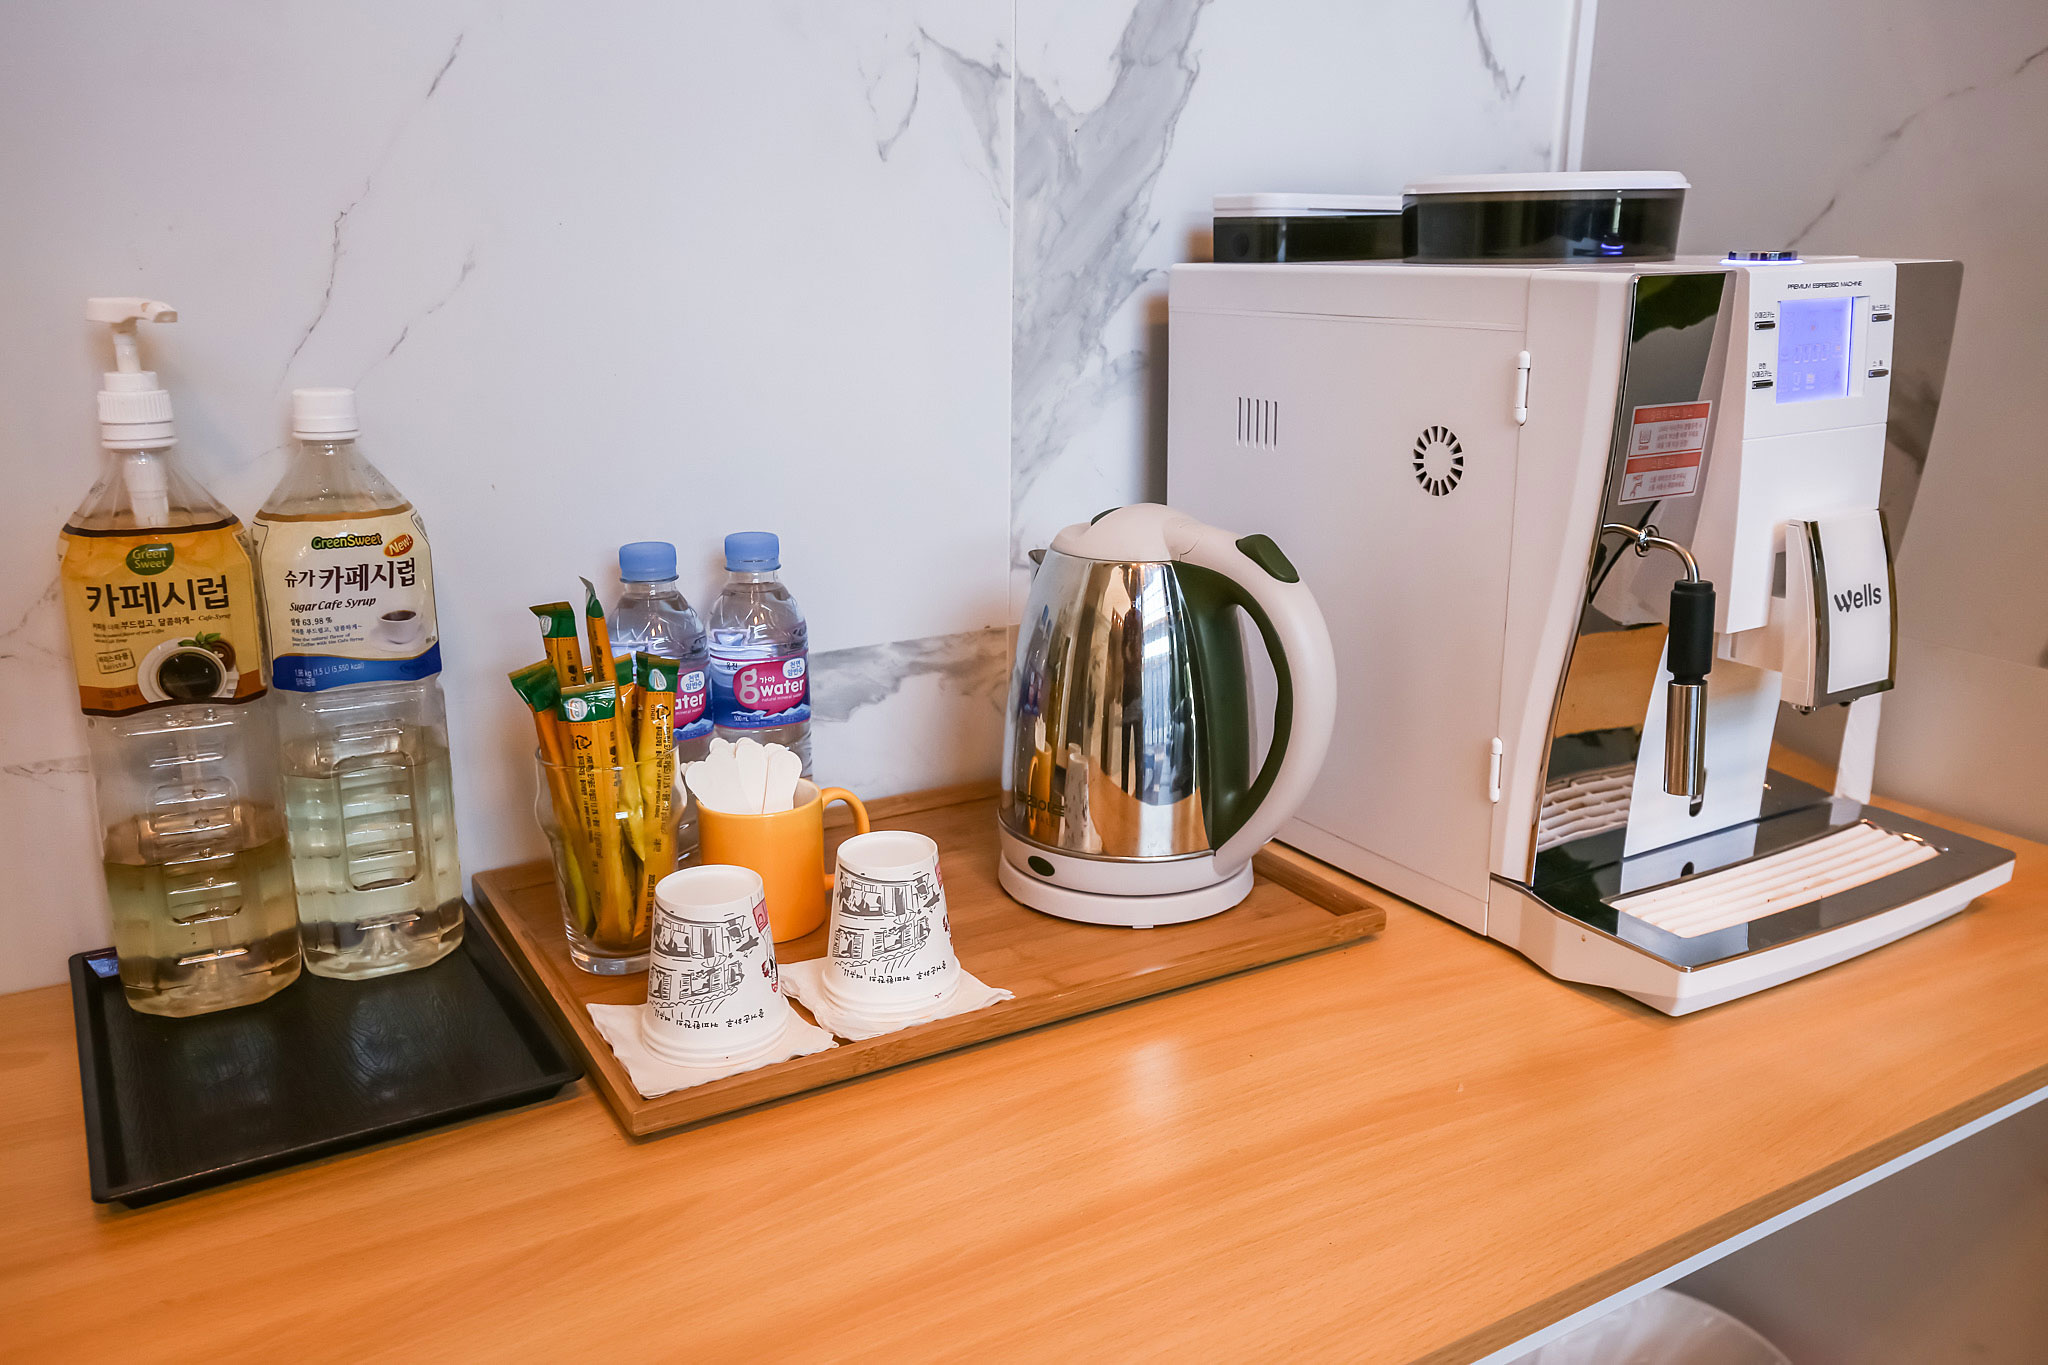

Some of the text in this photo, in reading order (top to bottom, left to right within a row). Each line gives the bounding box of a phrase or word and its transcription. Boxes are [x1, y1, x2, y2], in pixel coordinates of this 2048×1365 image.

[1812, 281, 1840, 289] ESPRESSO
[311, 532, 383, 550] GreenSweet
[388, 534, 413, 555] New!
[132, 548, 167, 560] Green
[135, 559, 167, 569] Sweet
[284, 557, 416, 594] 슈가 카페시럽
[85, 574, 230, 618] 카페시럽
[1833, 583, 1882, 612] Wells
[289, 597, 377, 614] Sugar Cafe Syrup
[302, 617, 324, 626] 63.98
[325, 616, 333, 624] %
[790, 659, 801, 668] 천연
[304, 670, 313, 679] kg
[688, 673, 700, 682] 천연
[787, 667, 803, 677] 암반수
[760, 675, 776, 684] 가야
[685, 681, 703, 690] 암반수
[760, 679, 805, 697] water
[674, 693, 704, 710] ater
